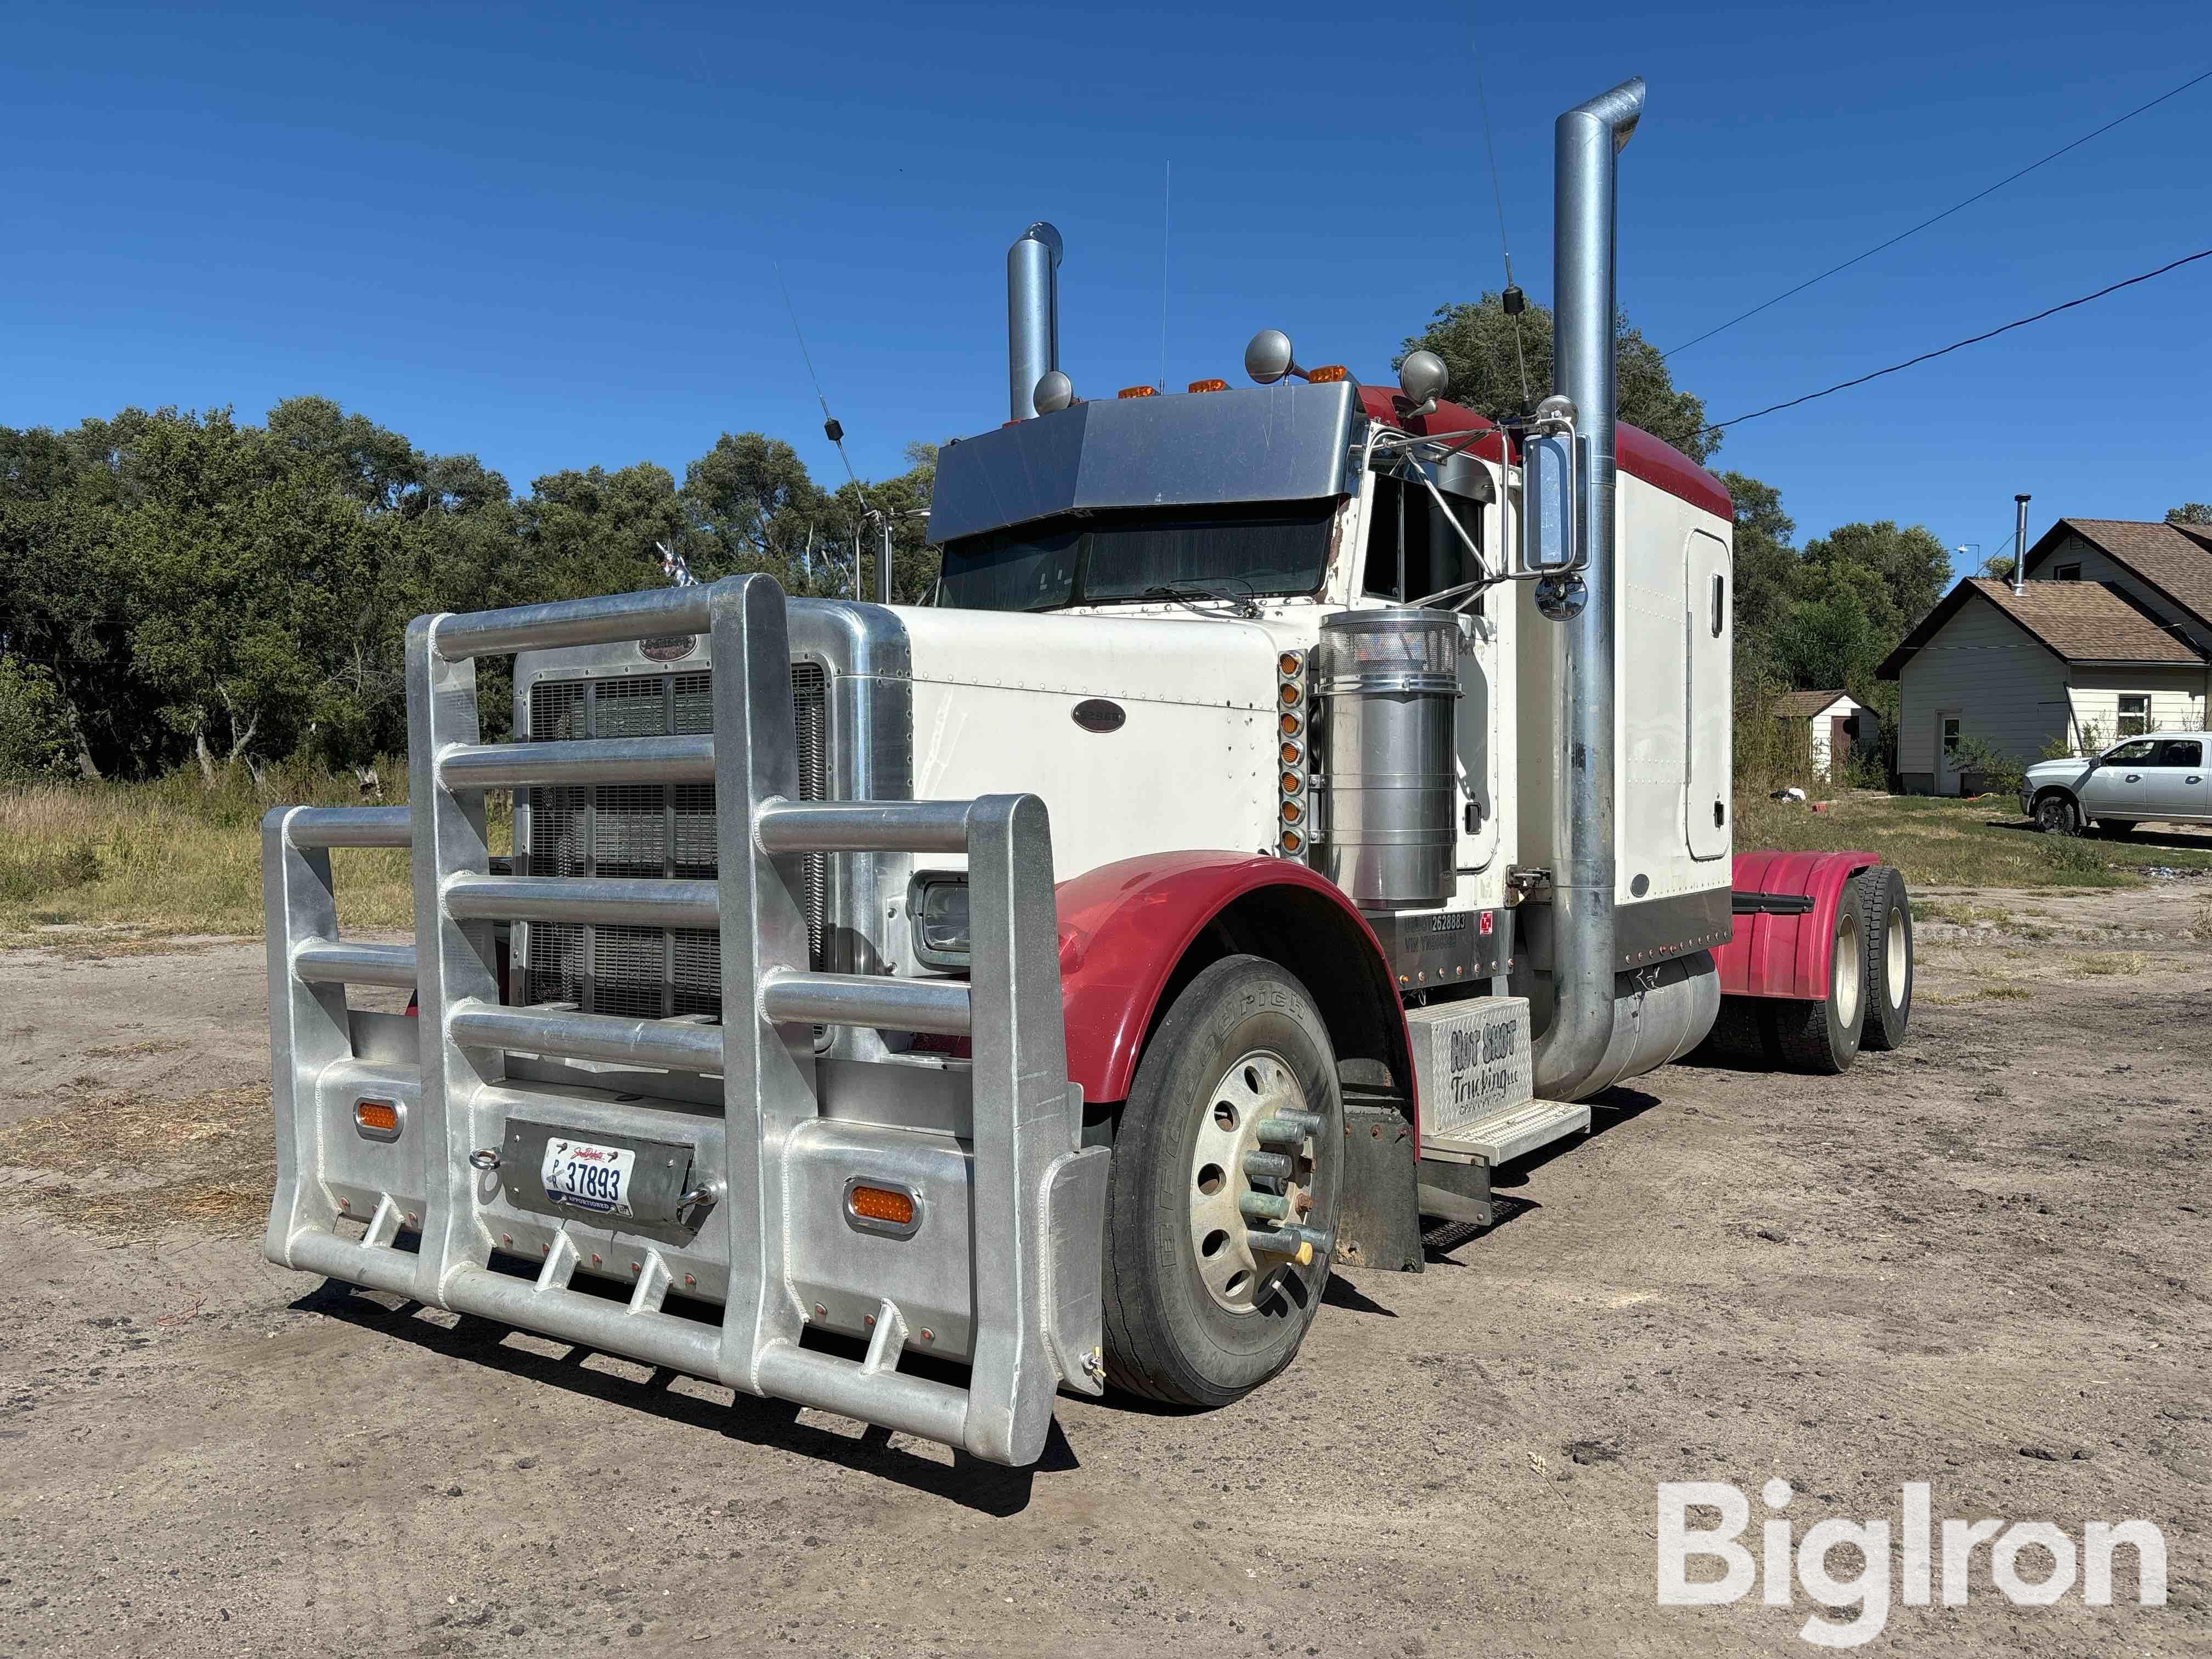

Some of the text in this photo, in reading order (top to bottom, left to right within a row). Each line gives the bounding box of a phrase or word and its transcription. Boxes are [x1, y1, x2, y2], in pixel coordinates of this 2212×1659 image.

[1432, 912, 1465, 932] 2628883
[1483, 1019, 1516, 1064] SHOT
[1451, 1066, 1506, 1104] Trucking
[565, 1161, 620, 1201] 37893
[568, 1195, 609, 1210] APPORTIONED
